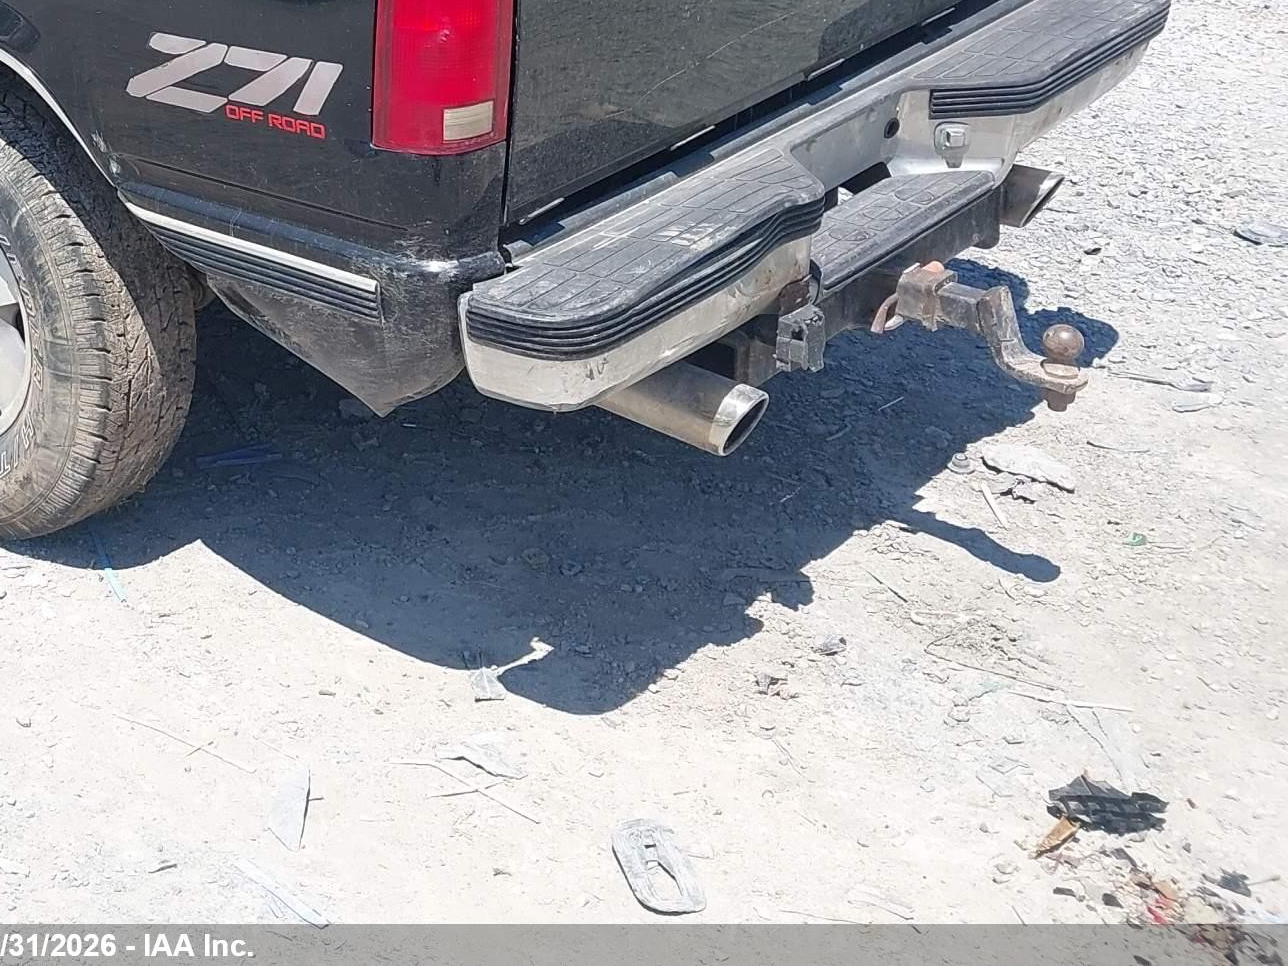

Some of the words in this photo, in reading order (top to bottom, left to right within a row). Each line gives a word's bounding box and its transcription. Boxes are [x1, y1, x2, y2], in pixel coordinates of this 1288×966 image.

[126, 32, 343, 115] Z71
[225, 104, 264, 124] OFF
[268, 113, 326, 139] ROAD
